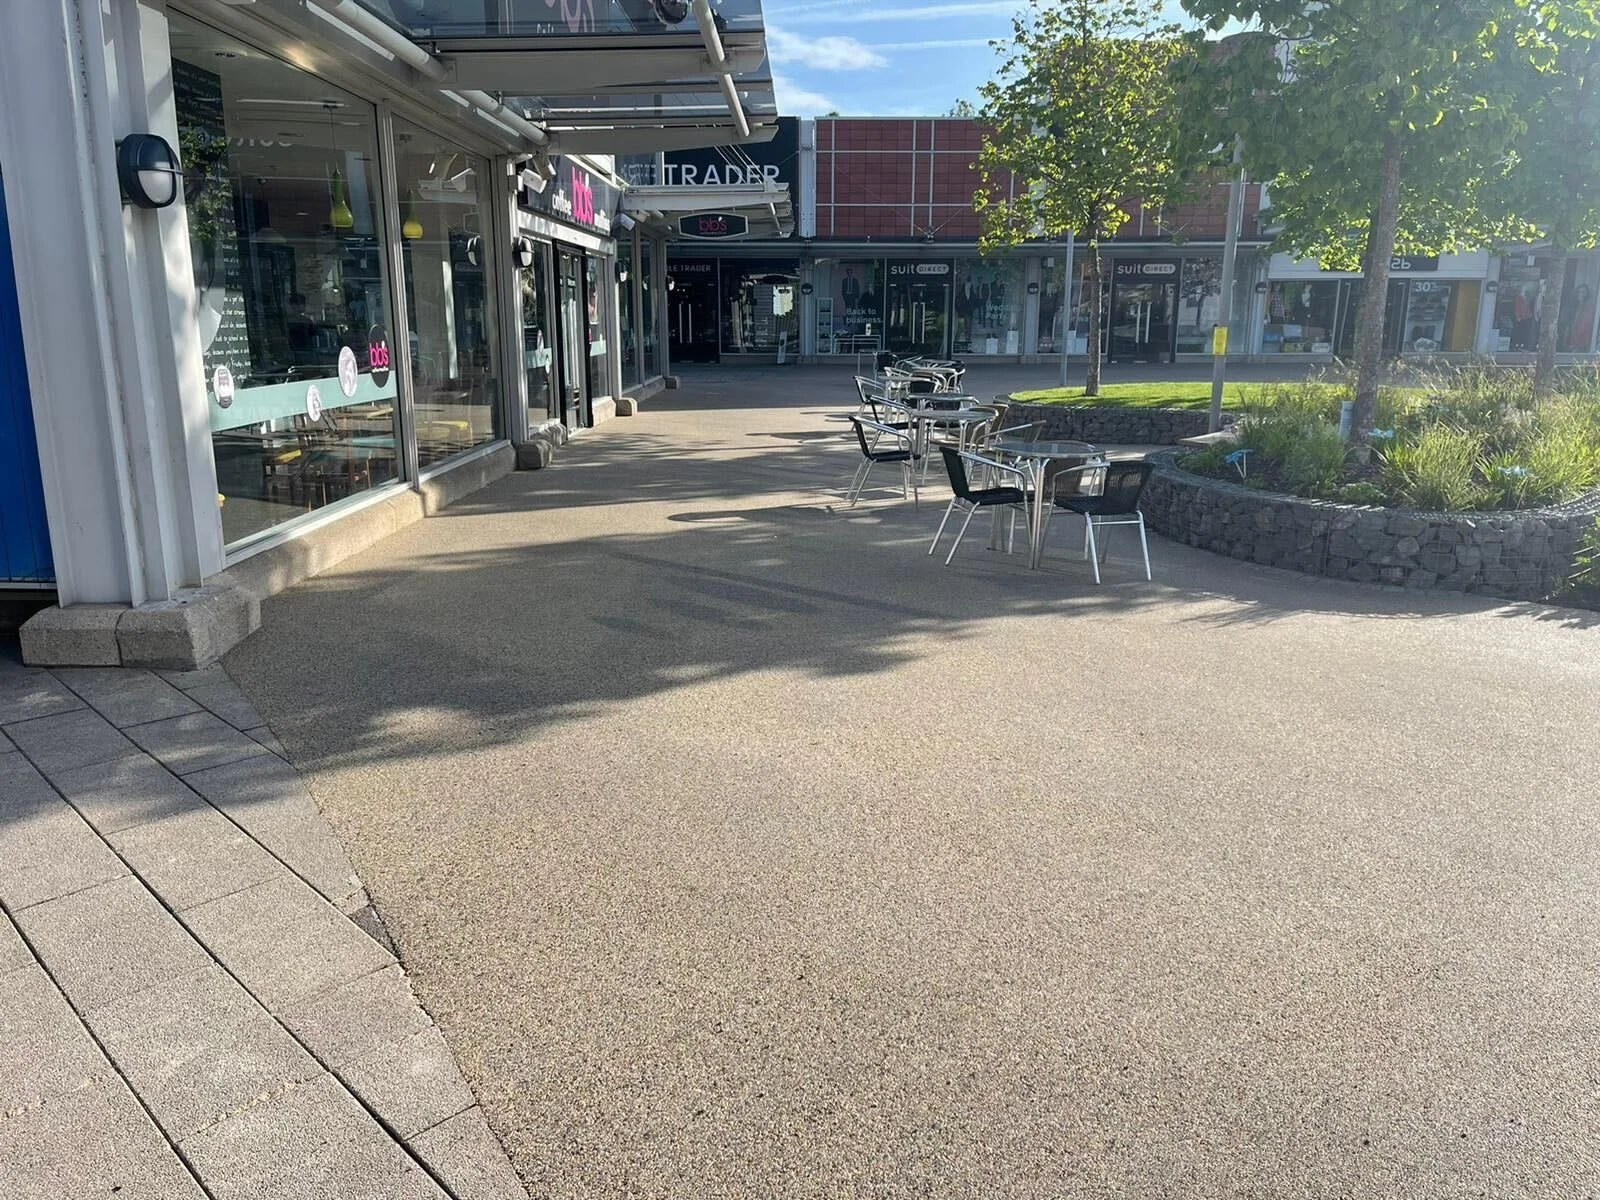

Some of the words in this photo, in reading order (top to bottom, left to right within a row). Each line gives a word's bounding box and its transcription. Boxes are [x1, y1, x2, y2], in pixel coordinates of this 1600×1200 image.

[664, 164, 780, 185] TRADER
[698, 215, 728, 232] bb's
[680, 264, 711, 272] TRADER
[891, 263, 915, 275] suit
[1117, 263, 1141, 274] suit
[846, 307, 867, 315] Back
[867, 307, 877, 315] to
[369, 341, 389, 367] bb's
